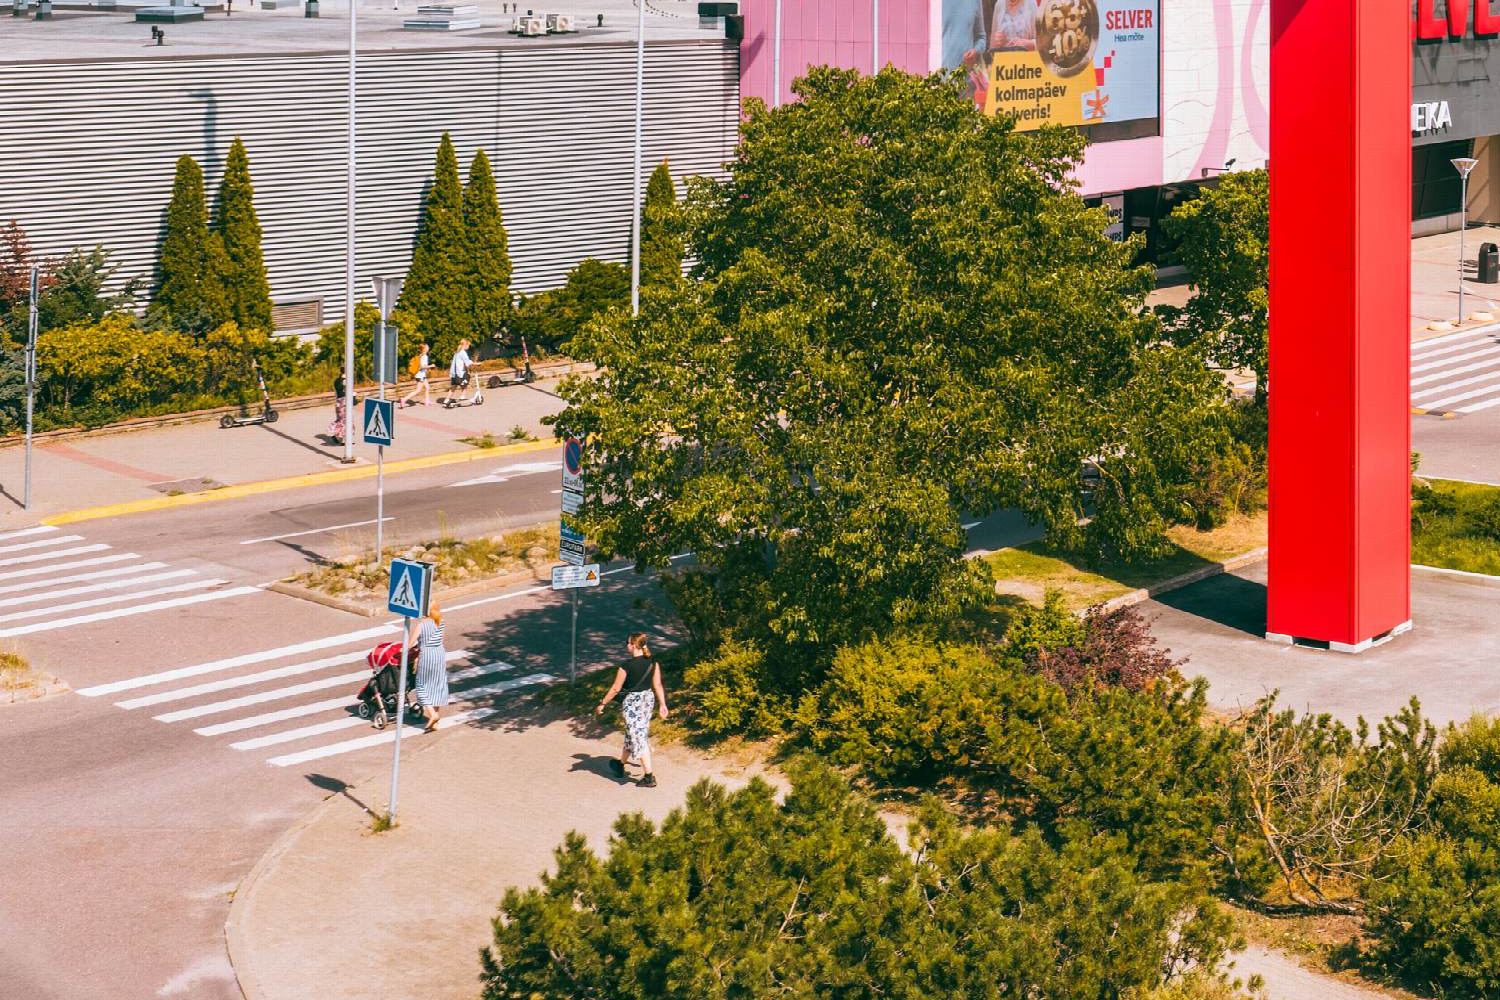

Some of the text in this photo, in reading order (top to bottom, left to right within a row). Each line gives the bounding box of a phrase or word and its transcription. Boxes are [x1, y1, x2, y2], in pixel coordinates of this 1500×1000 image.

[1105, 10, 1152, 30] SELVER
[995, 64, 1042, 81] Kuldne
[995, 82, 1067, 102] kolmapäev
